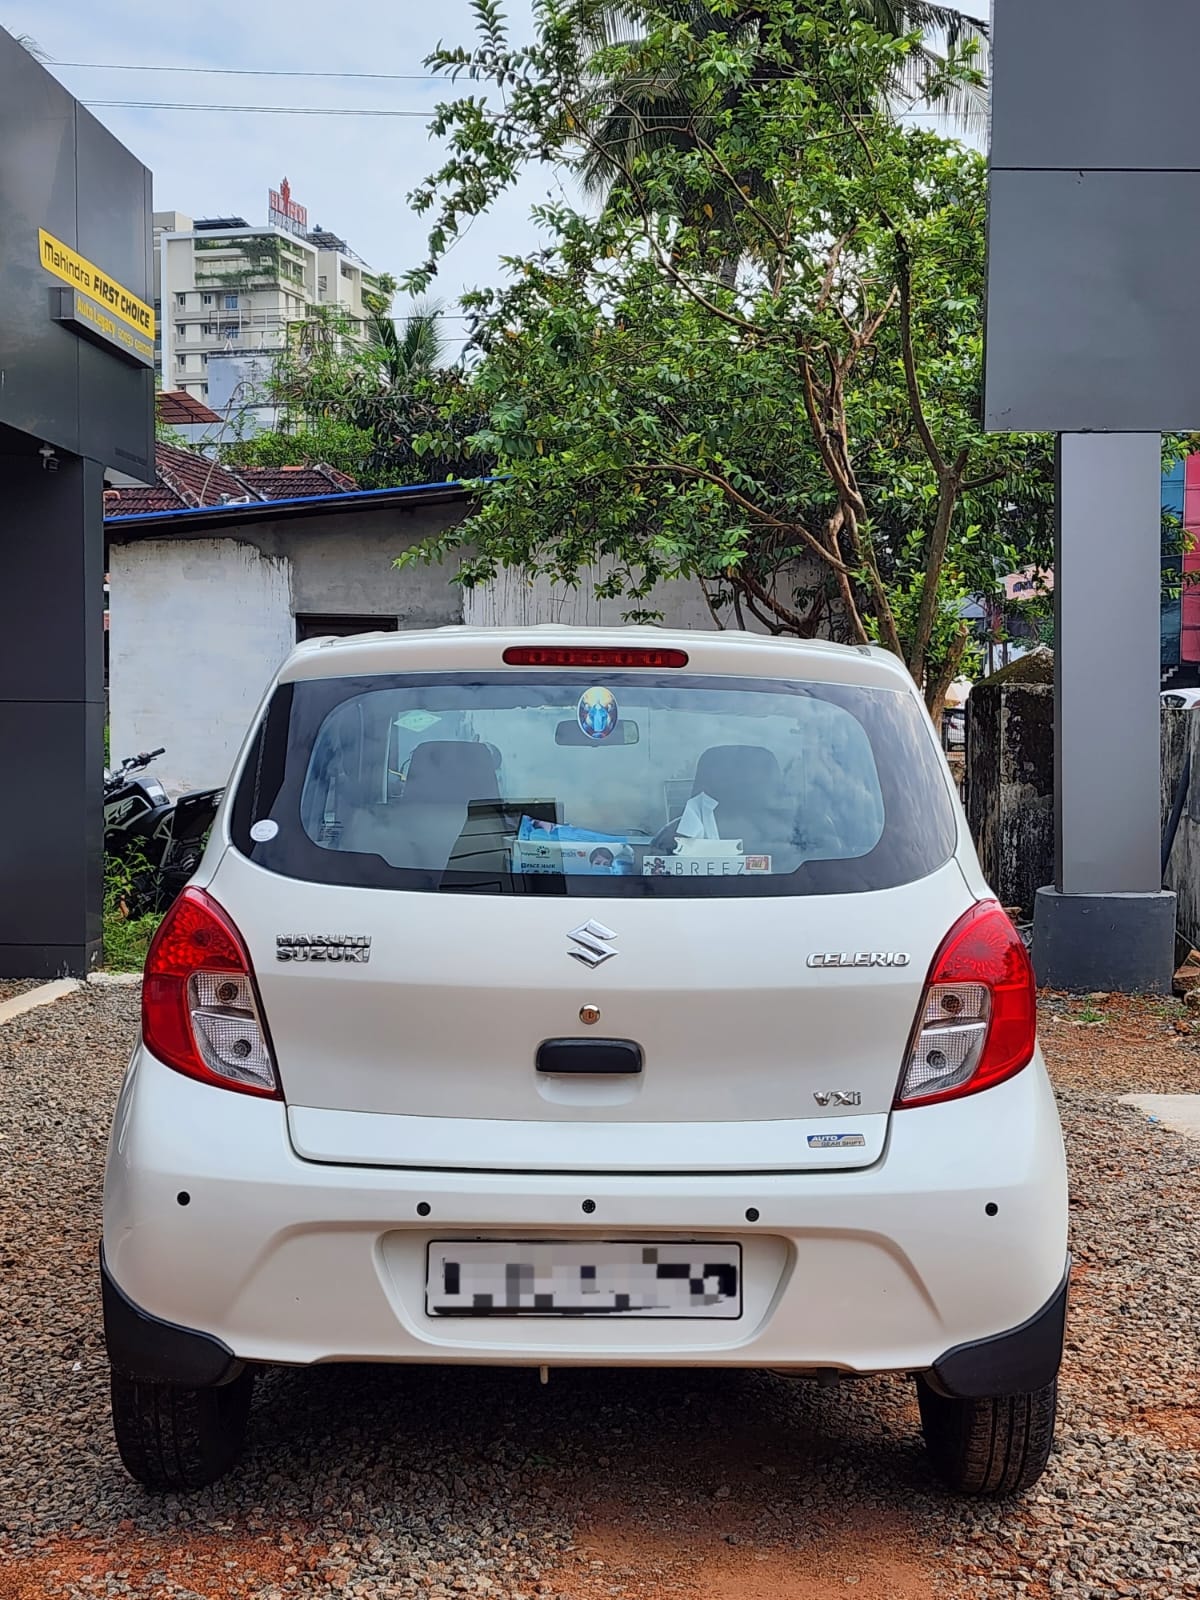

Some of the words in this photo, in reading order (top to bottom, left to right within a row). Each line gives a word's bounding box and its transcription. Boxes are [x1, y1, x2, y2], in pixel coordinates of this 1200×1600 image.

[44, 240, 90, 287] Mahindra
[94, 275, 120, 307] FIRST
[120, 296, 150, 329] CHOICE
[276, 934, 371, 948] MARUTI
[276, 946, 370, 962] SUZUKI
[806, 952, 911, 968] CELERIO
